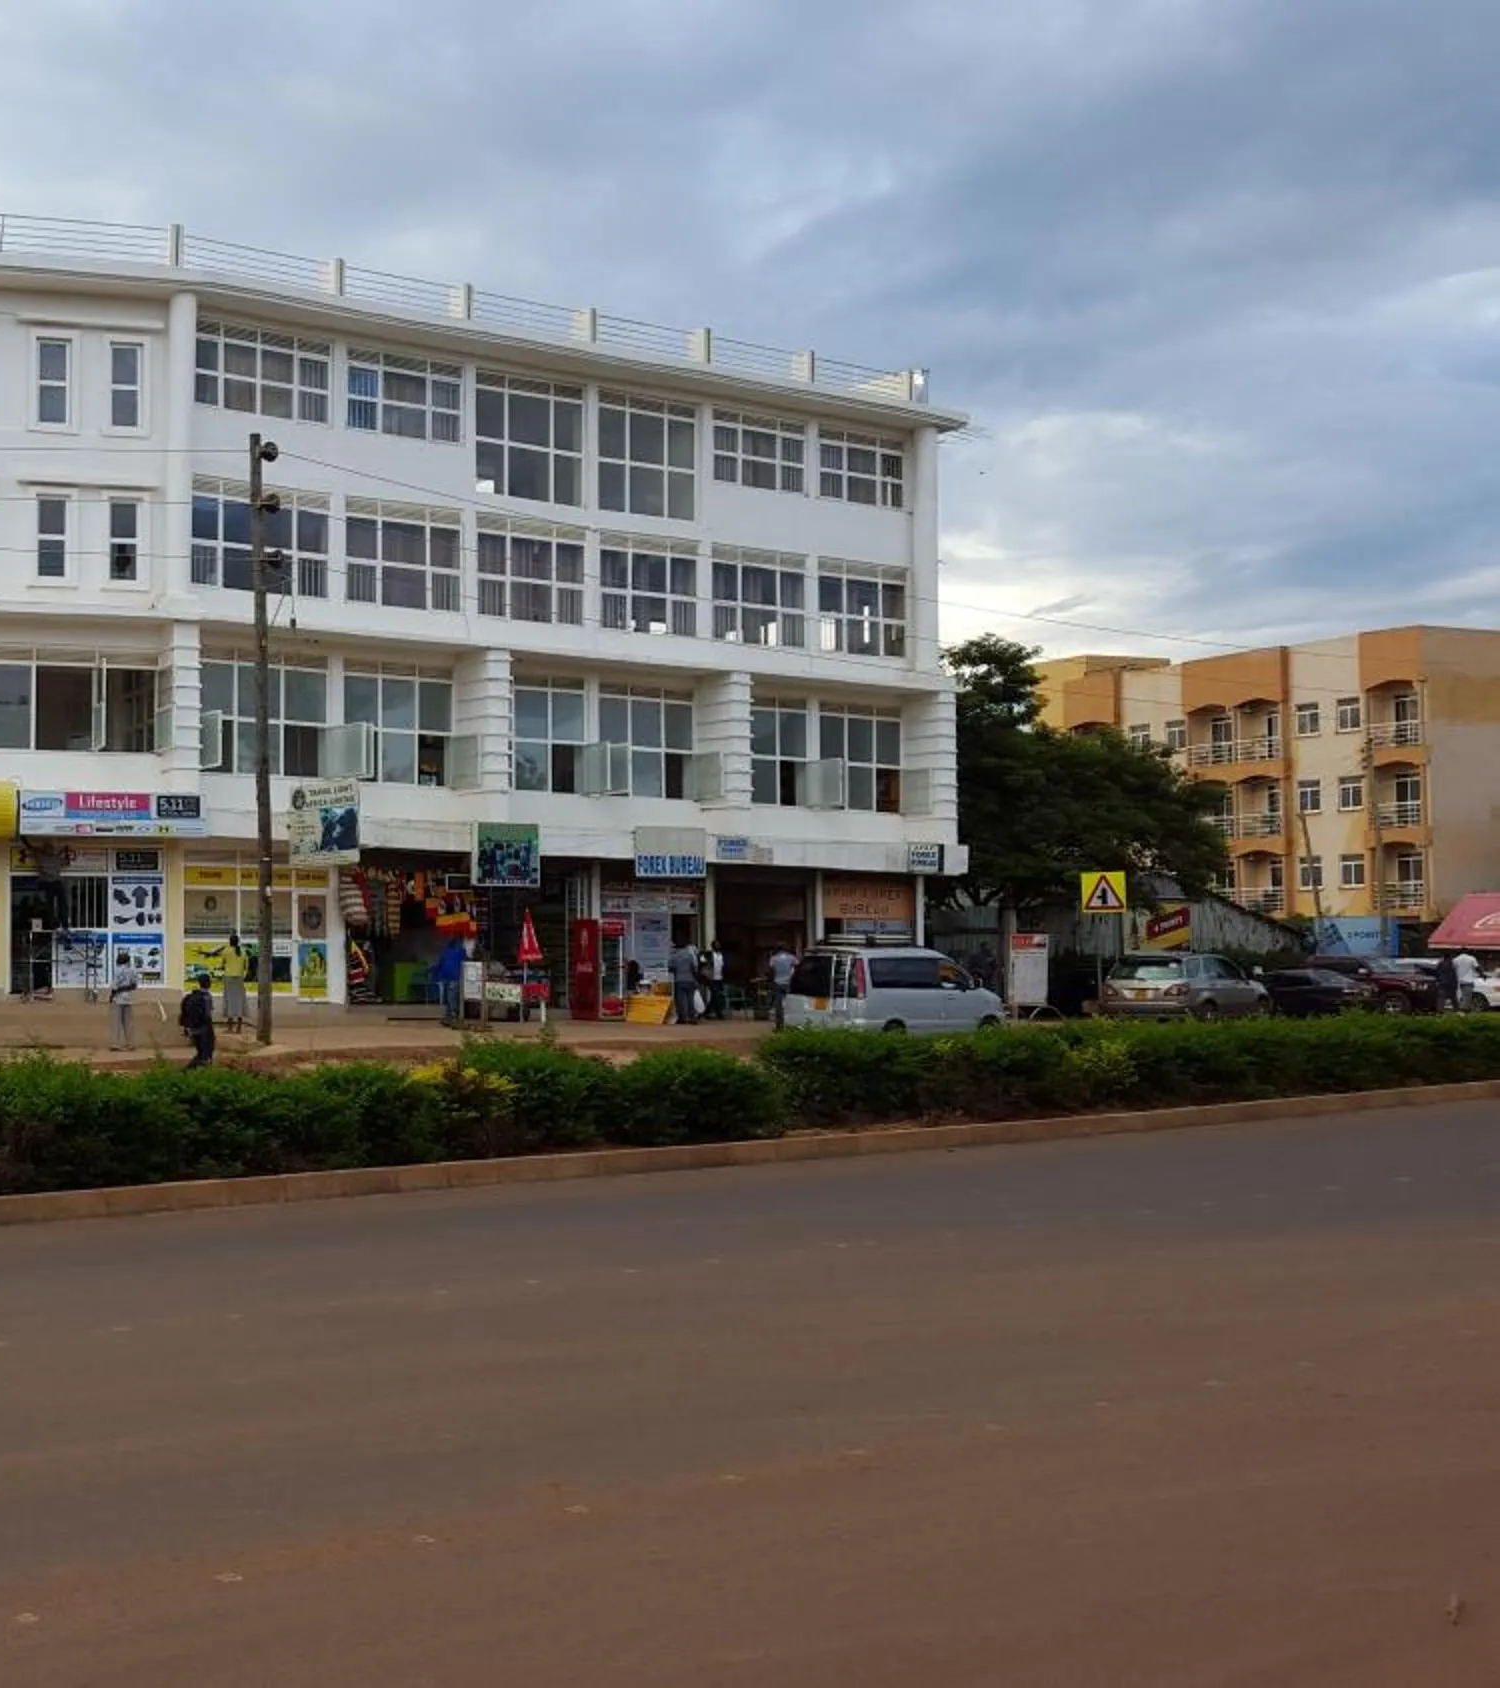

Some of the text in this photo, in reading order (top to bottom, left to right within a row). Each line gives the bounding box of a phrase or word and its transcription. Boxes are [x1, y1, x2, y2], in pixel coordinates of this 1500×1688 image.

[78, 794, 137, 811] Lifestyle
[638, 855, 705, 875] FOREX BUREAU
